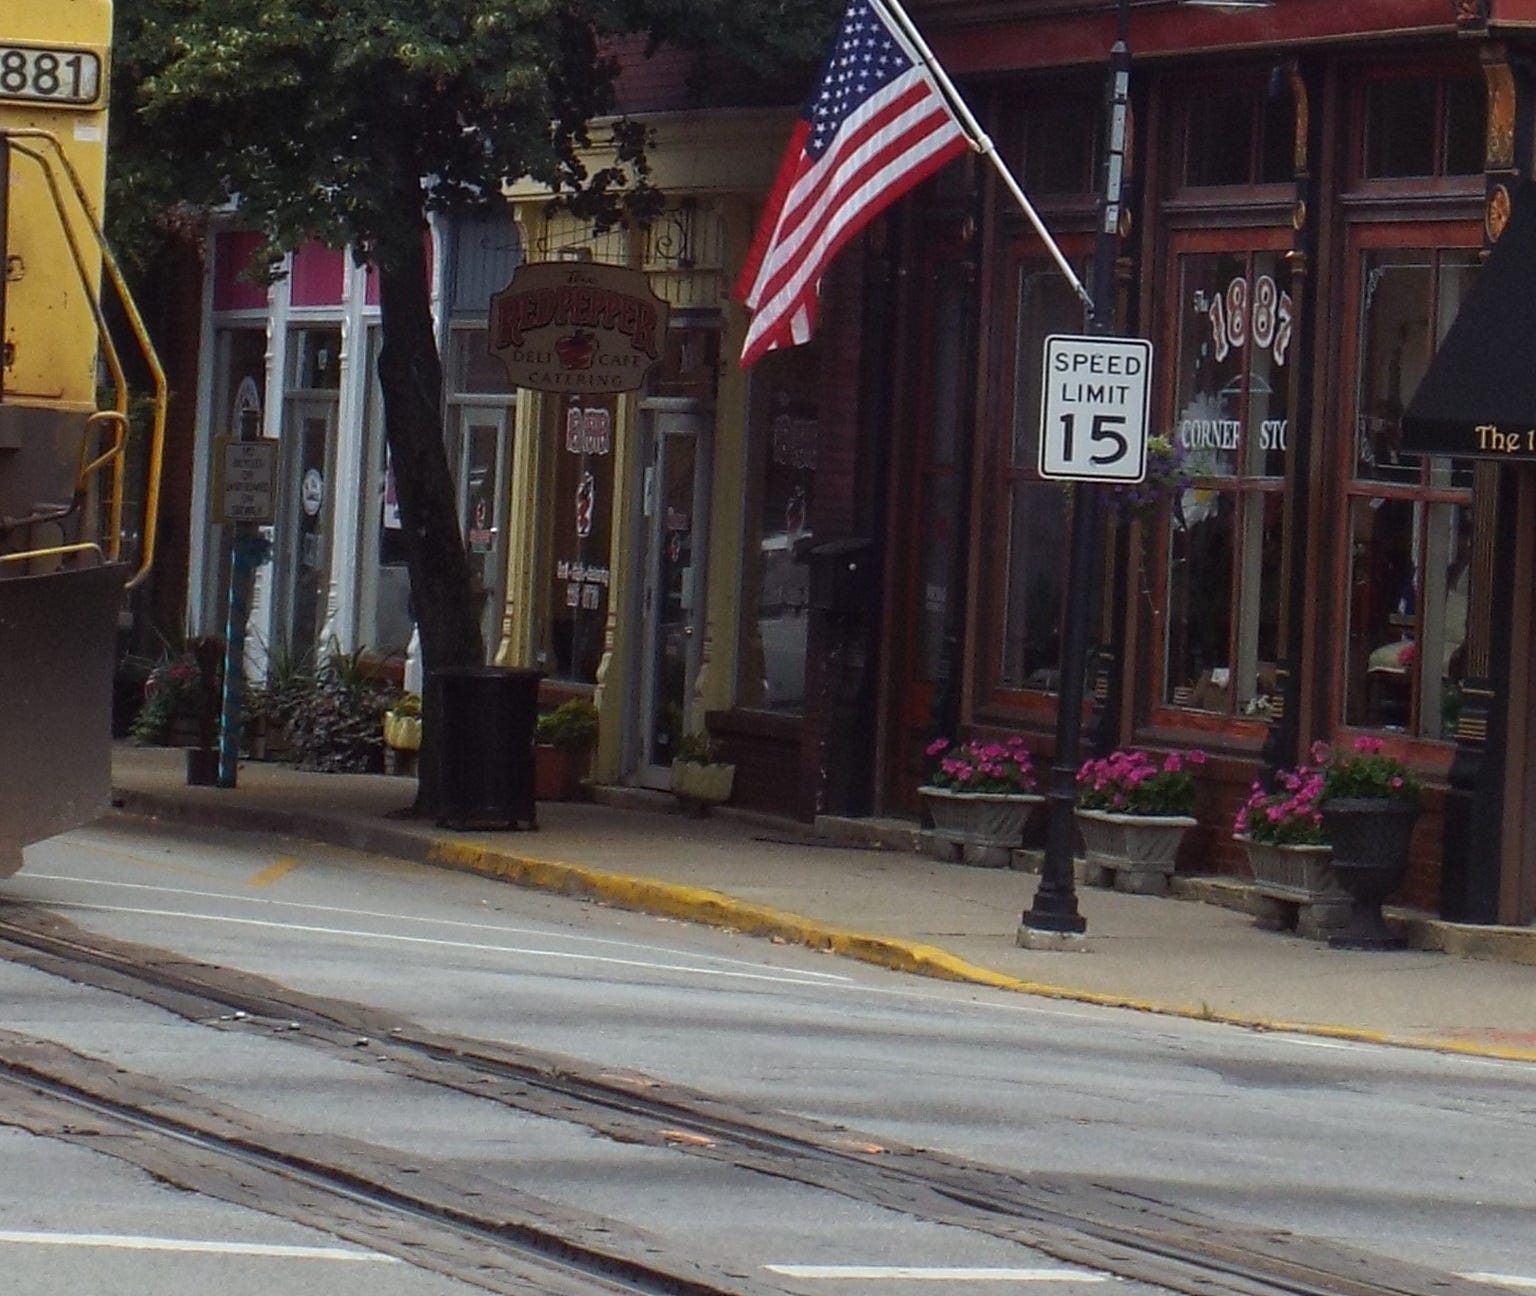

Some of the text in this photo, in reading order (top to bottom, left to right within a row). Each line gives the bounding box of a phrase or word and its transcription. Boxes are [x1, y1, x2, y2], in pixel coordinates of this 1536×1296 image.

[1210, 275, 1293, 367] 1887
[514, 350, 553, 364] DELI
[1055, 352, 1141, 376] SPEED
[529, 371, 622, 387] CATERING
[1062, 383, 1130, 405] LIMIT
[1060, 413, 1128, 464] 15
[1475, 424, 1520, 452] The
